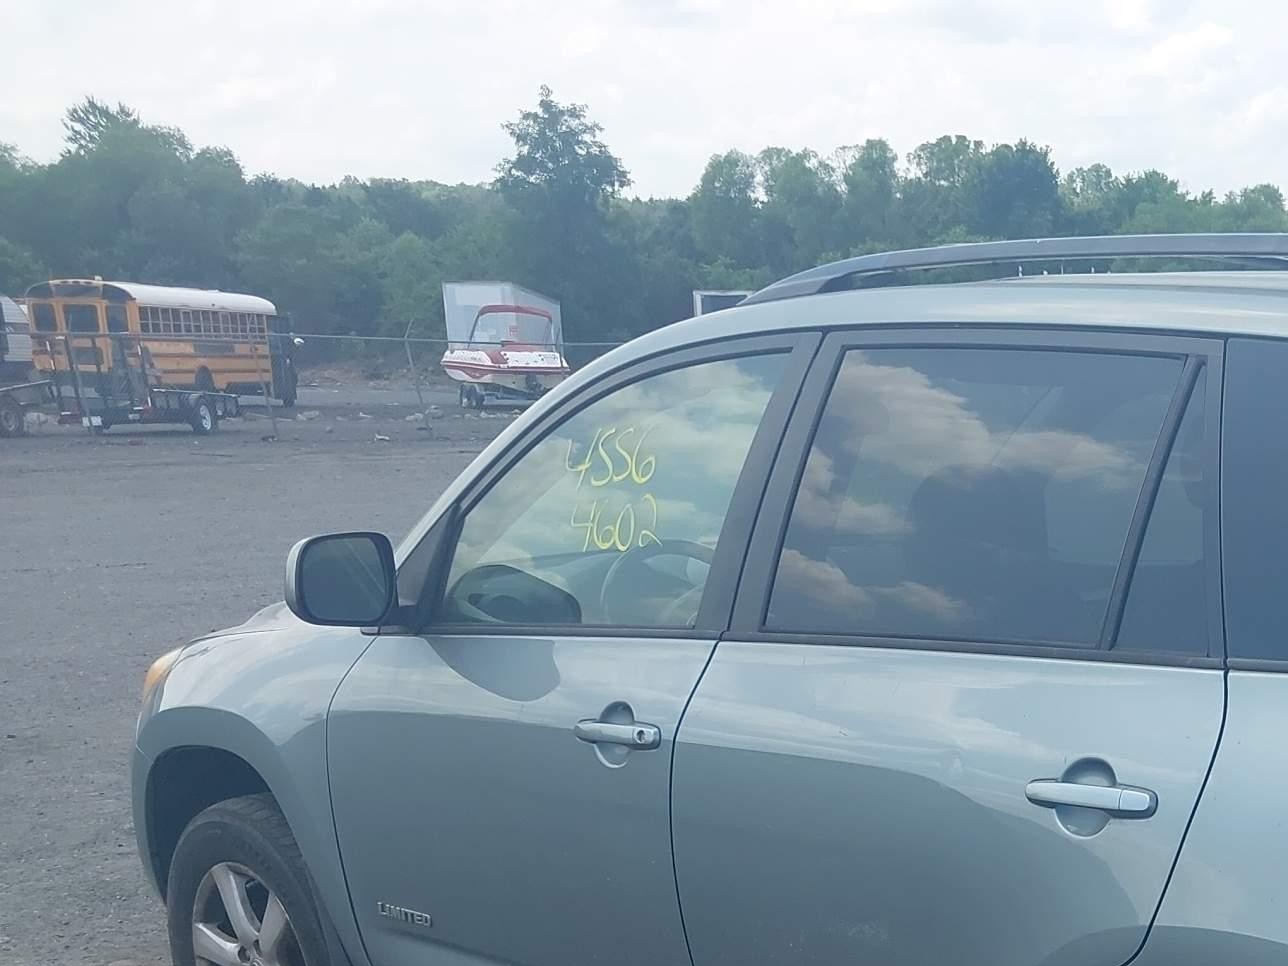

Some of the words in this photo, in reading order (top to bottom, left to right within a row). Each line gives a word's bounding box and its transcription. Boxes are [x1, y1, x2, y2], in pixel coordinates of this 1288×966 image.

[566, 427, 656, 490] 4556
[570, 493, 664, 552] 4602
[377, 902, 432, 927] LIMITED
